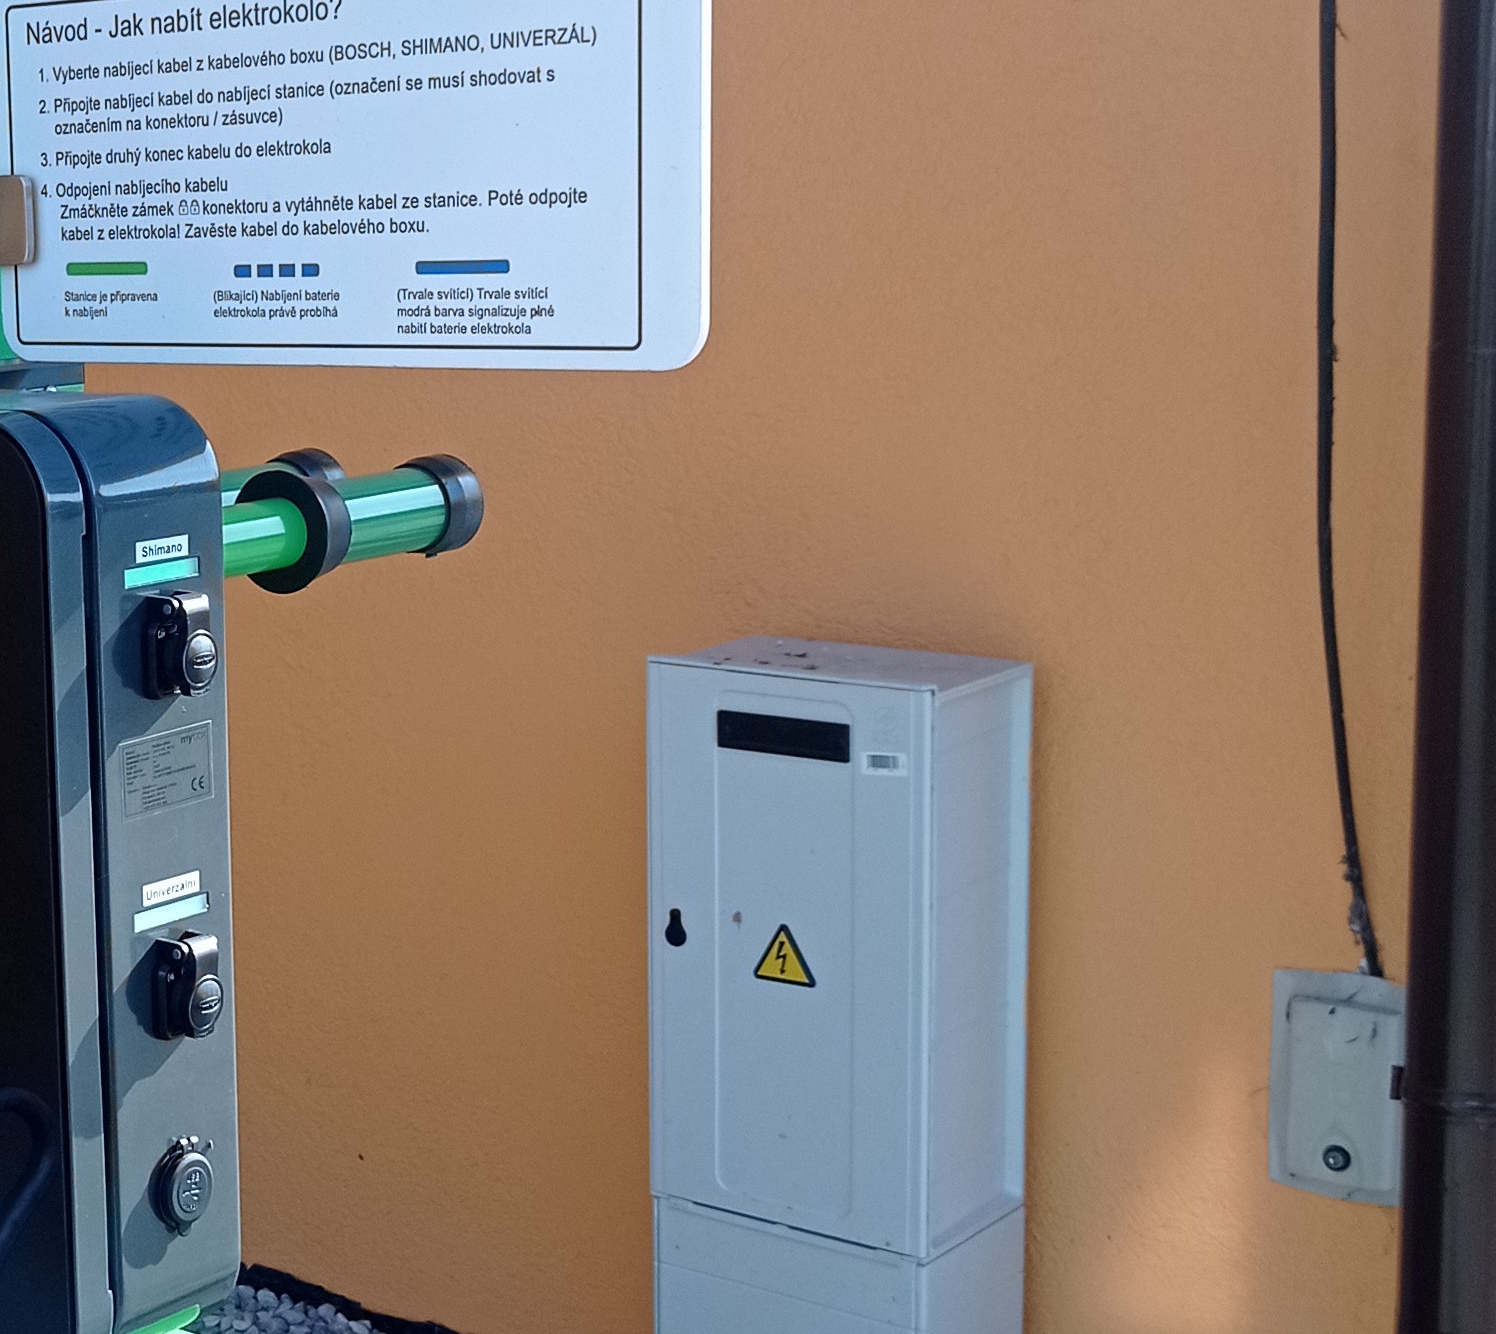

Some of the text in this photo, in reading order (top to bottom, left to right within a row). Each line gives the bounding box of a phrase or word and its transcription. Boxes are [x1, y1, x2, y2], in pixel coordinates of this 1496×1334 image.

[27, 18, 87, 45] Návod
[109, 13, 143, 38] Jak
[151, 8, 202, 34] nabít
[39, 23, 596, 84] 1. Vyberte nabíjecí kabel z kabelového boxu (BOSCH, SHIMANO, UNIVERZÁL)
[39, 67, 555, 115] 2. Připojte nabíjecí kabel do nabíjecí stanice (označení se musí shodovat s
[55, 117, 121, 135] označením
[127, 120, 141, 131] na
[146, 114, 209, 130] konektoru
[222, 107, 282, 126] zásuvce)
[41, 139, 331, 169] 3. Připojte druhý konec kabelu do elektrokola
[41, 177, 227, 200] 4. Odpojení nabíjecího kabelu
[61, 187, 587, 219] Zmáčkněte zámek konektoru a vytáhněte kabel ze stanice. Poté odpojte
[61, 218, 429, 241] kabel z elektrokola! Zavěste kabel do kabelového boxu.
[65, 291, 157, 304] Stanice je připravena
[261, 290, 302, 304] Nabíjení
[305, 290, 339, 301] baterie
[397, 287, 548, 302] (Trvale svítící) Trvale svítící
[65, 307, 107, 320] k nabíjení
[214, 306, 337, 320] elektrokola právě probíhá
[398, 305, 554, 320] modrá barva signalizuje plné
[398, 322, 531, 334] nabití baterie elektrokola
[141, 542, 183, 558] Shimano
